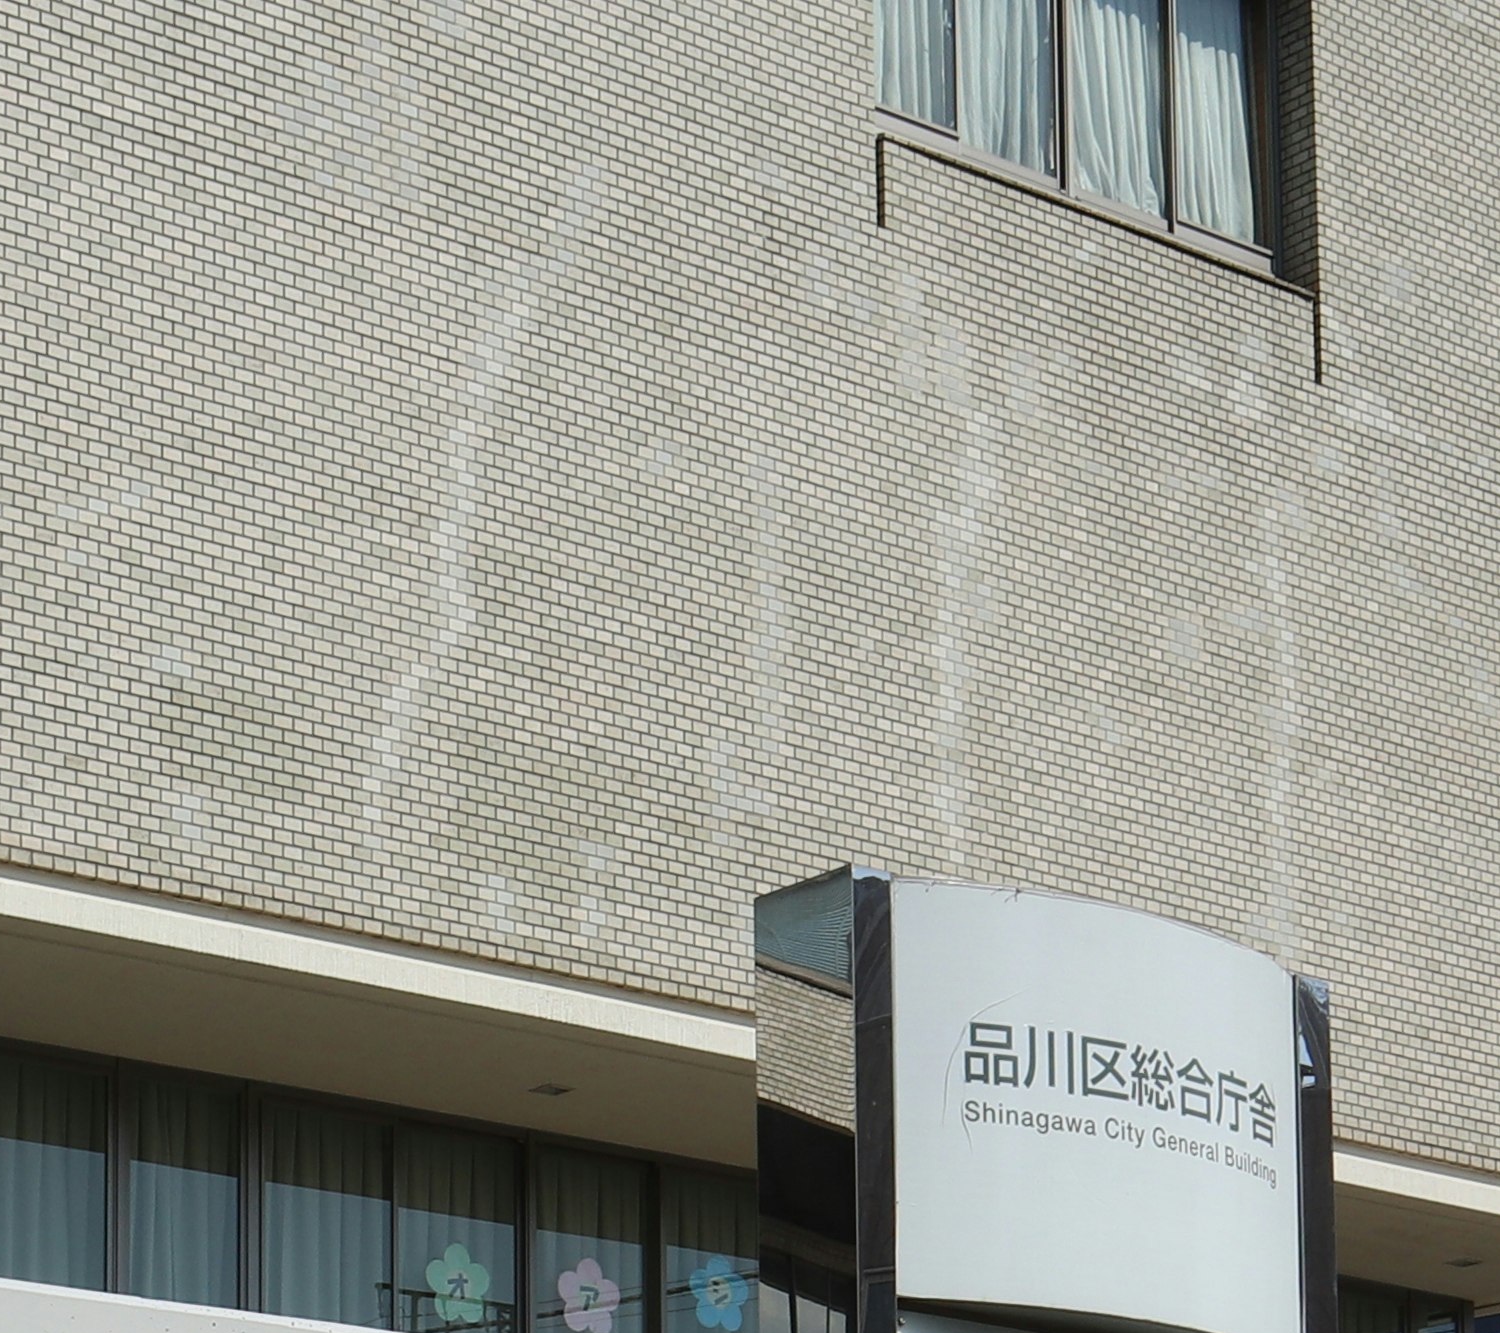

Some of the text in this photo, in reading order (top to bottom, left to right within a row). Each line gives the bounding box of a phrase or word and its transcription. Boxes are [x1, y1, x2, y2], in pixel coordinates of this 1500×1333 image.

[964, 1021, 1277, 1148] 品川区総合庁舎
[964, 1100, 1278, 1190] Shinagawa City General Building
[447, 1273, 468, 1299] オ
[580, 1285, 599, 1311] ア
